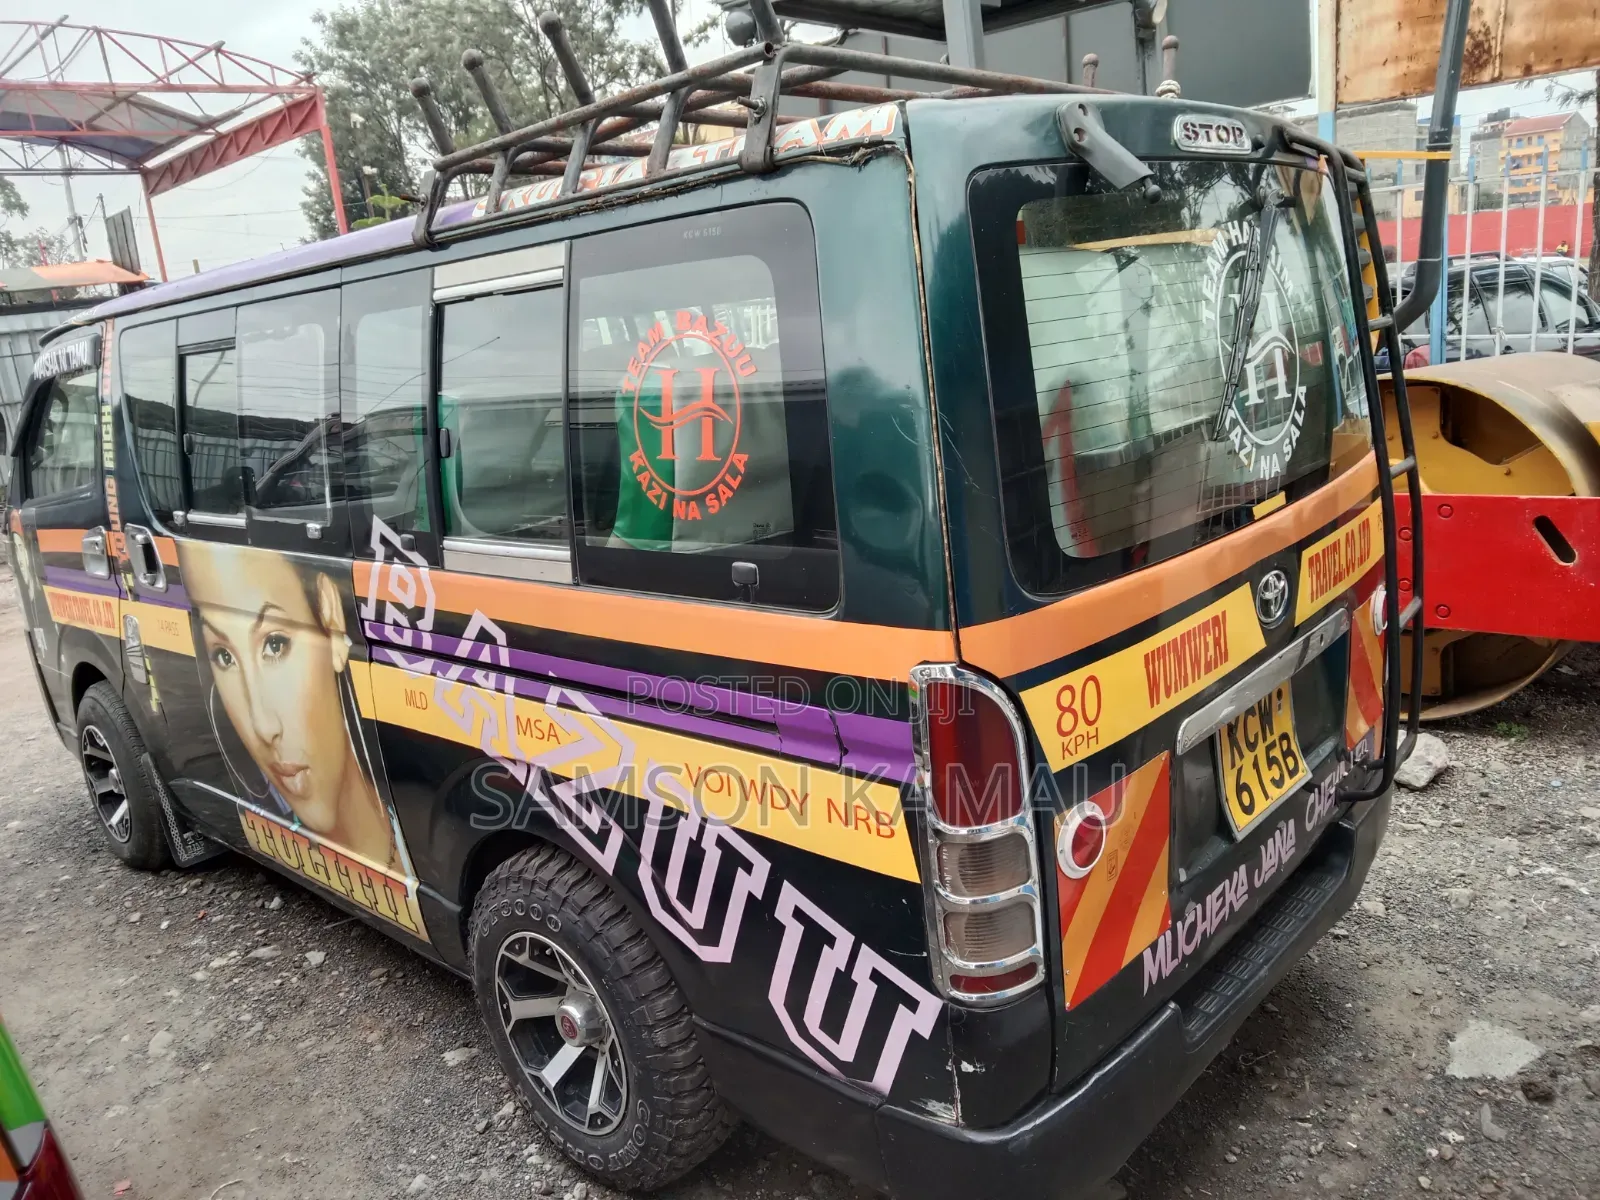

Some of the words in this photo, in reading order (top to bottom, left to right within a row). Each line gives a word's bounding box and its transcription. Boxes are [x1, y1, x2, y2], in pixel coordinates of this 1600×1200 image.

[1183, 122, 1243, 144] STOP
[1202, 230, 1230, 324] TEAM
[622, 322, 665, 394] TEAM
[676, 311, 757, 377] BAZUU
[1260, 453, 1281, 481] NA
[1283, 386, 1307, 461] SALA
[629, 450, 667, 510] KAZI
[673, 498, 702, 520] NA
[705, 453, 749, 514] SALA
[1144, 610, 1229, 709] WUMWERI
[1056, 675, 1102, 738] 80
[1061, 727, 1099, 760] KPH
[1227, 692, 1275, 770] KCW
[405, 688, 428, 710] MLD
[516, 715, 561, 745] MSA
[685, 763, 731, 796] VOI
[739, 776, 810, 816] WDY
[827, 798, 895, 839] NRB
[1236, 732, 1300, 816] 615B
[1254, 818, 1297, 889] JANA
